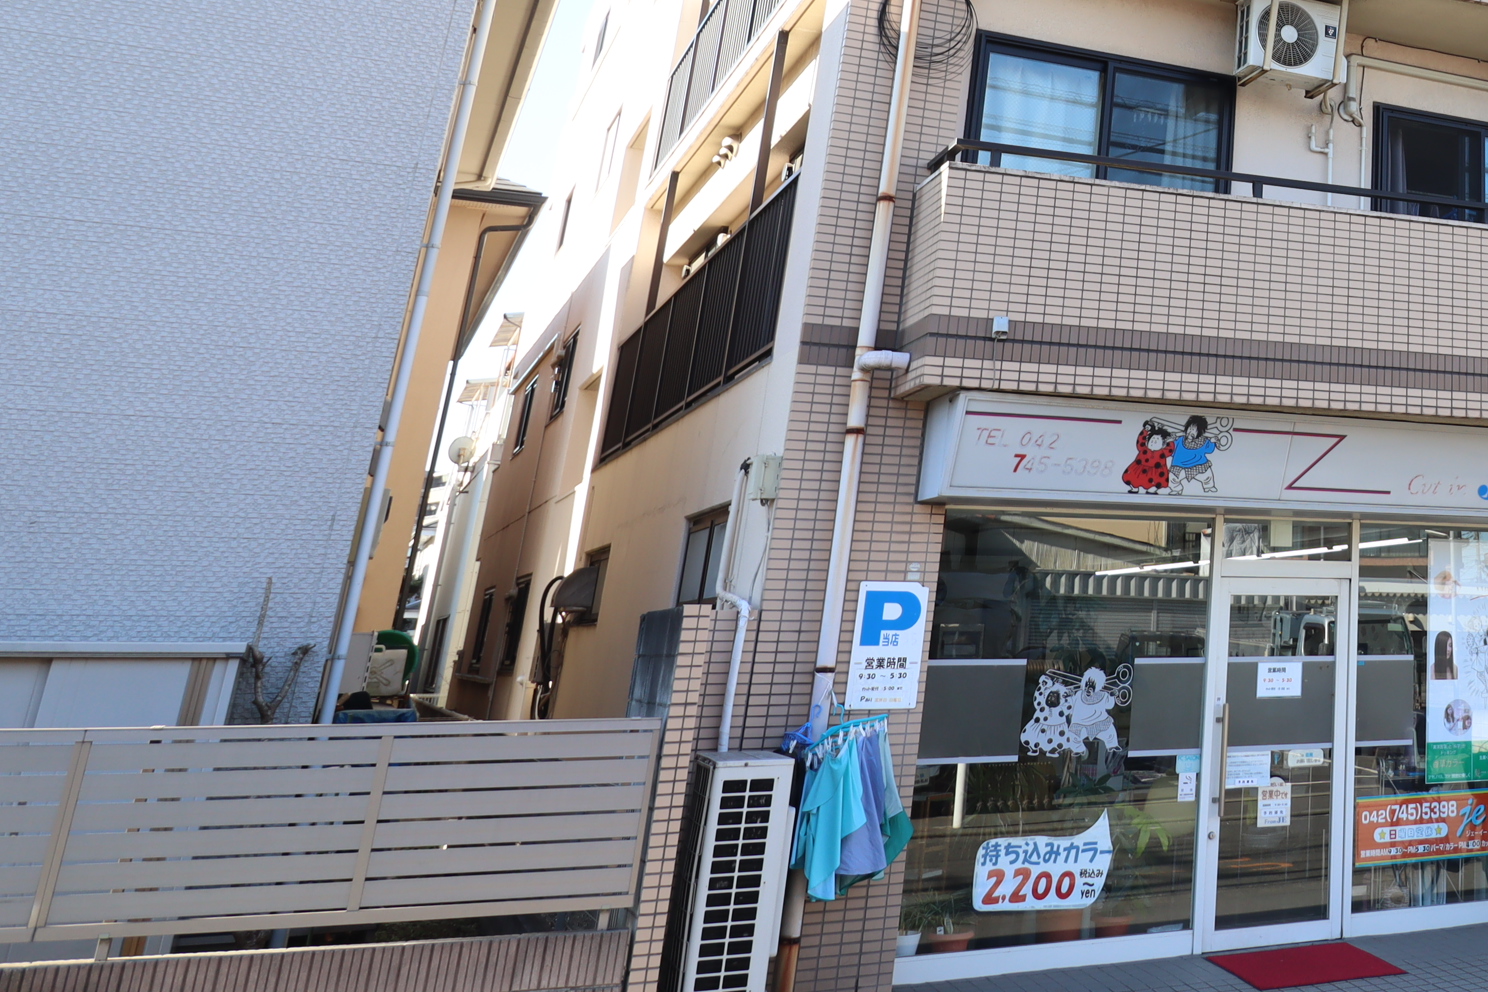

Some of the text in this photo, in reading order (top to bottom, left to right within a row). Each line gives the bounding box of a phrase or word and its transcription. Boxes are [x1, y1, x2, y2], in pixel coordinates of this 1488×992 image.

[976, 427, 1060, 450] TEL 042
[859, 590, 922, 646] P
[881, 632, 900, 647] 当店
[864, 657, 907, 669] 営業時間
[1261, 790, 1288, 800] 営業中です
[1361, 800, 1457, 824] 042(745)5398
[1456, 797, 1487, 837] je
[1389, 826, 1434, 839] 日曜日定休
[980, 840, 1113, 866] 持ち込みカラー
[1079, 868, 1104, 879] 税込み
[981, 866, 1076, 905] 2,200
[1080, 888, 1096, 899] yen
